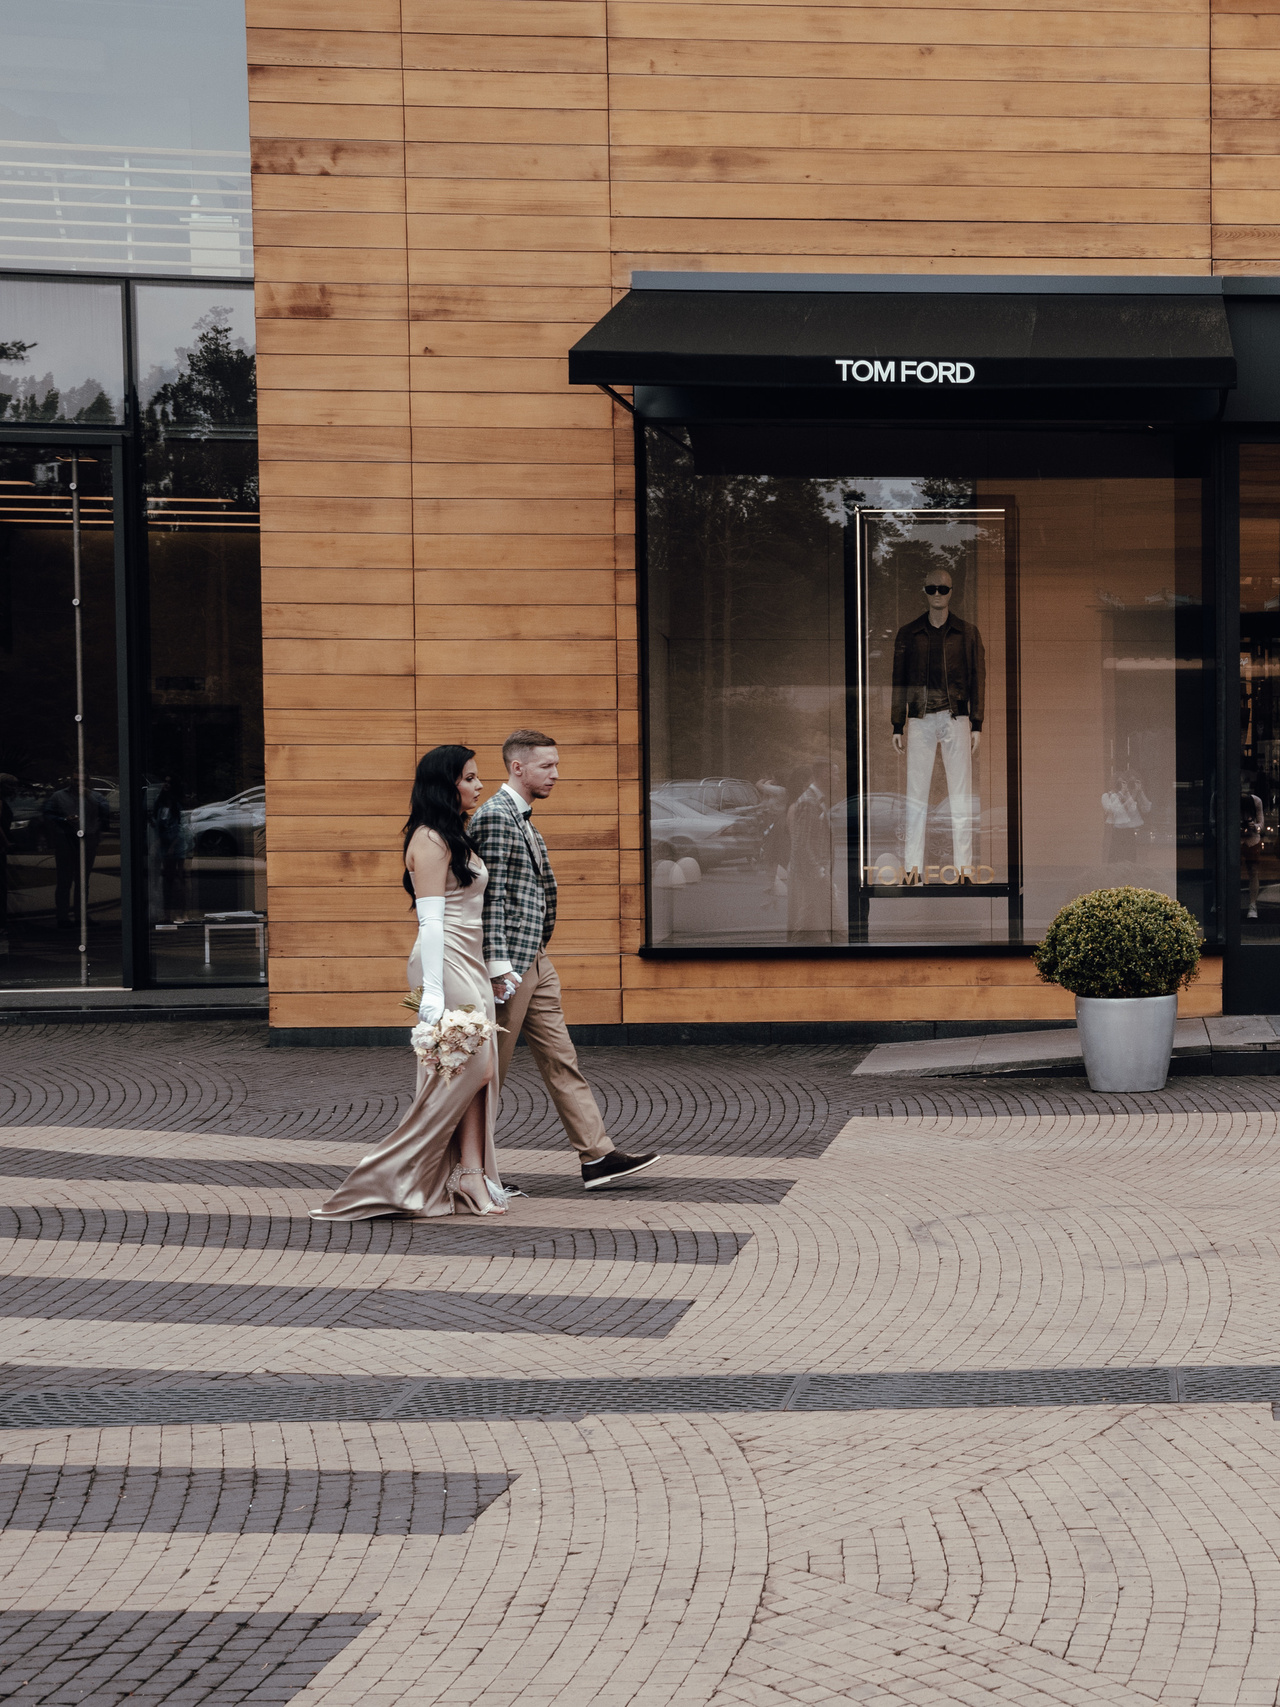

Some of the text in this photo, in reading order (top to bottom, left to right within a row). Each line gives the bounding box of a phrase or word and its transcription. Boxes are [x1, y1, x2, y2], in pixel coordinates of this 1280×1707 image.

[835, 359, 976, 384] TOM FORD
[863, 864, 996, 886] TOM FORD
